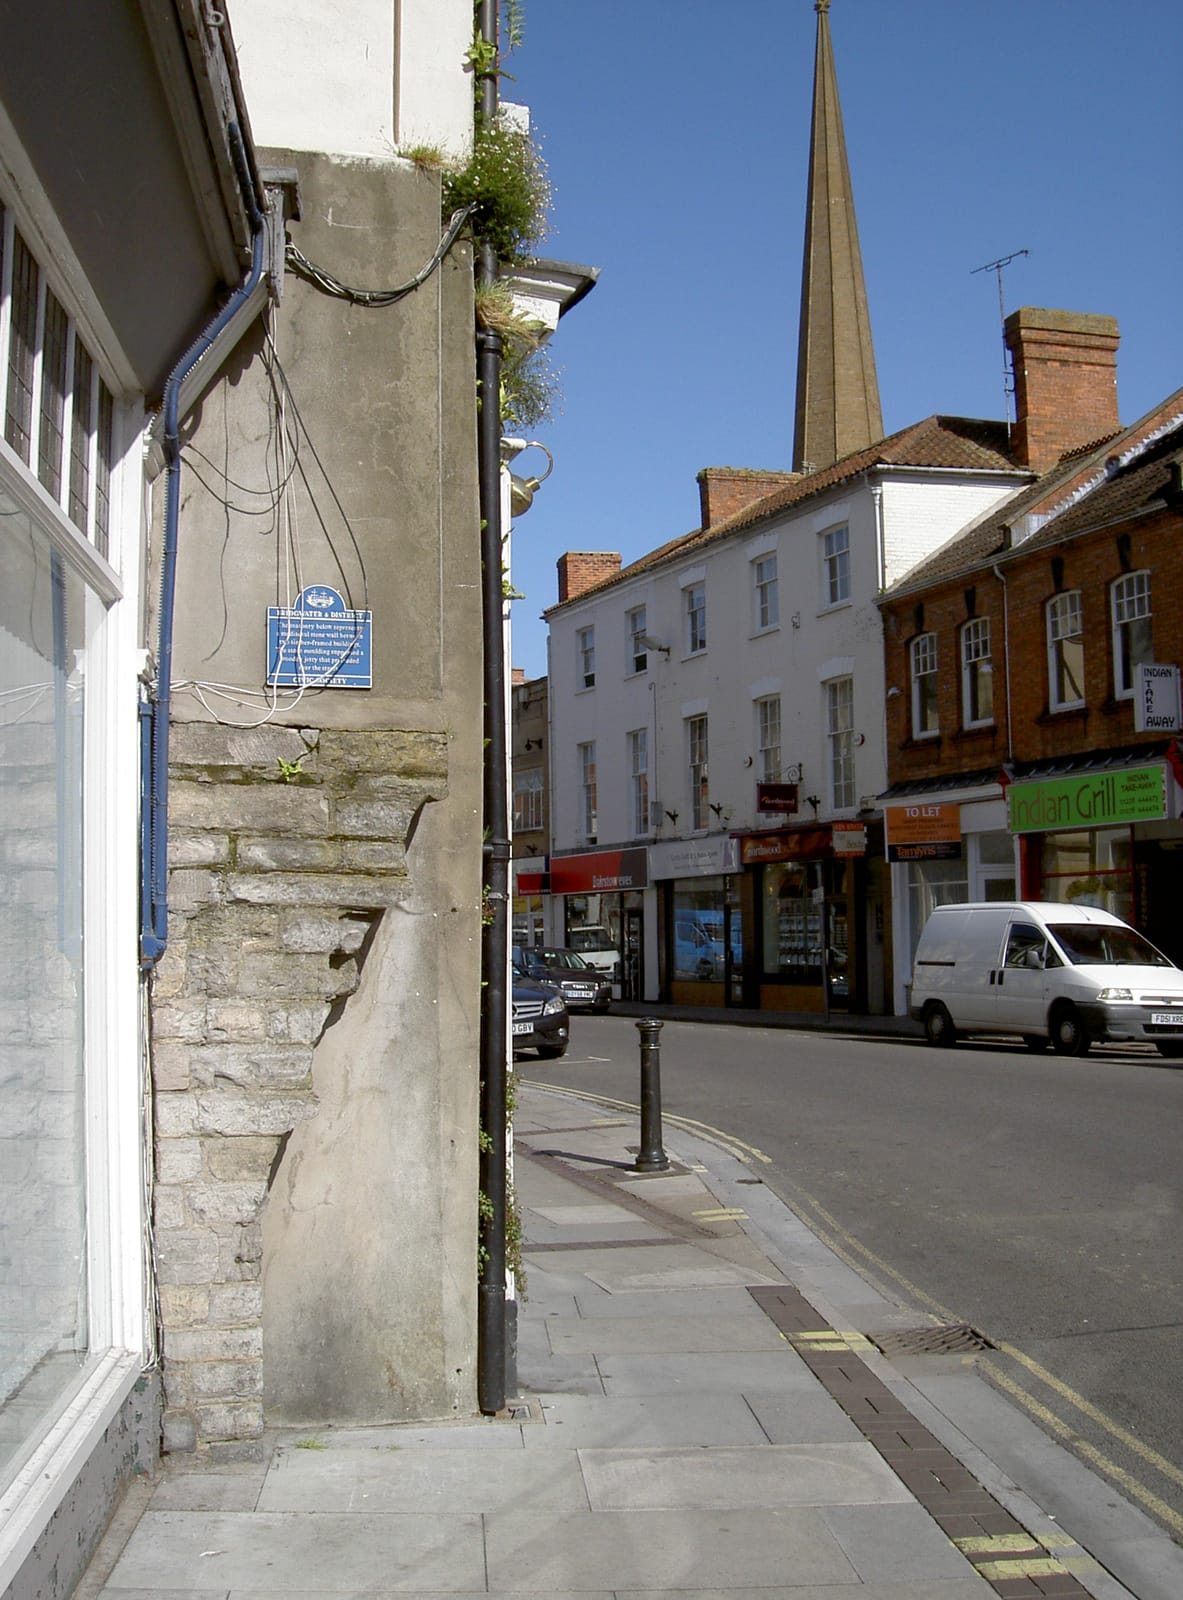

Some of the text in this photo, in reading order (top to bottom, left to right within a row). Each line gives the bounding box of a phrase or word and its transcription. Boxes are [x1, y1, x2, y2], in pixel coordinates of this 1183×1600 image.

[1144, 668, 1172, 678] INDIAN
[315, 677, 347, 685] OCIETY
[1145, 680, 1153, 713] TAKE
[1146, 716, 1175, 728] AWAY
[1011, 776, 1116, 826] Indian Grill
[904, 806, 941, 817] TO LET
[518, 1024, 533, 1032] GBV
